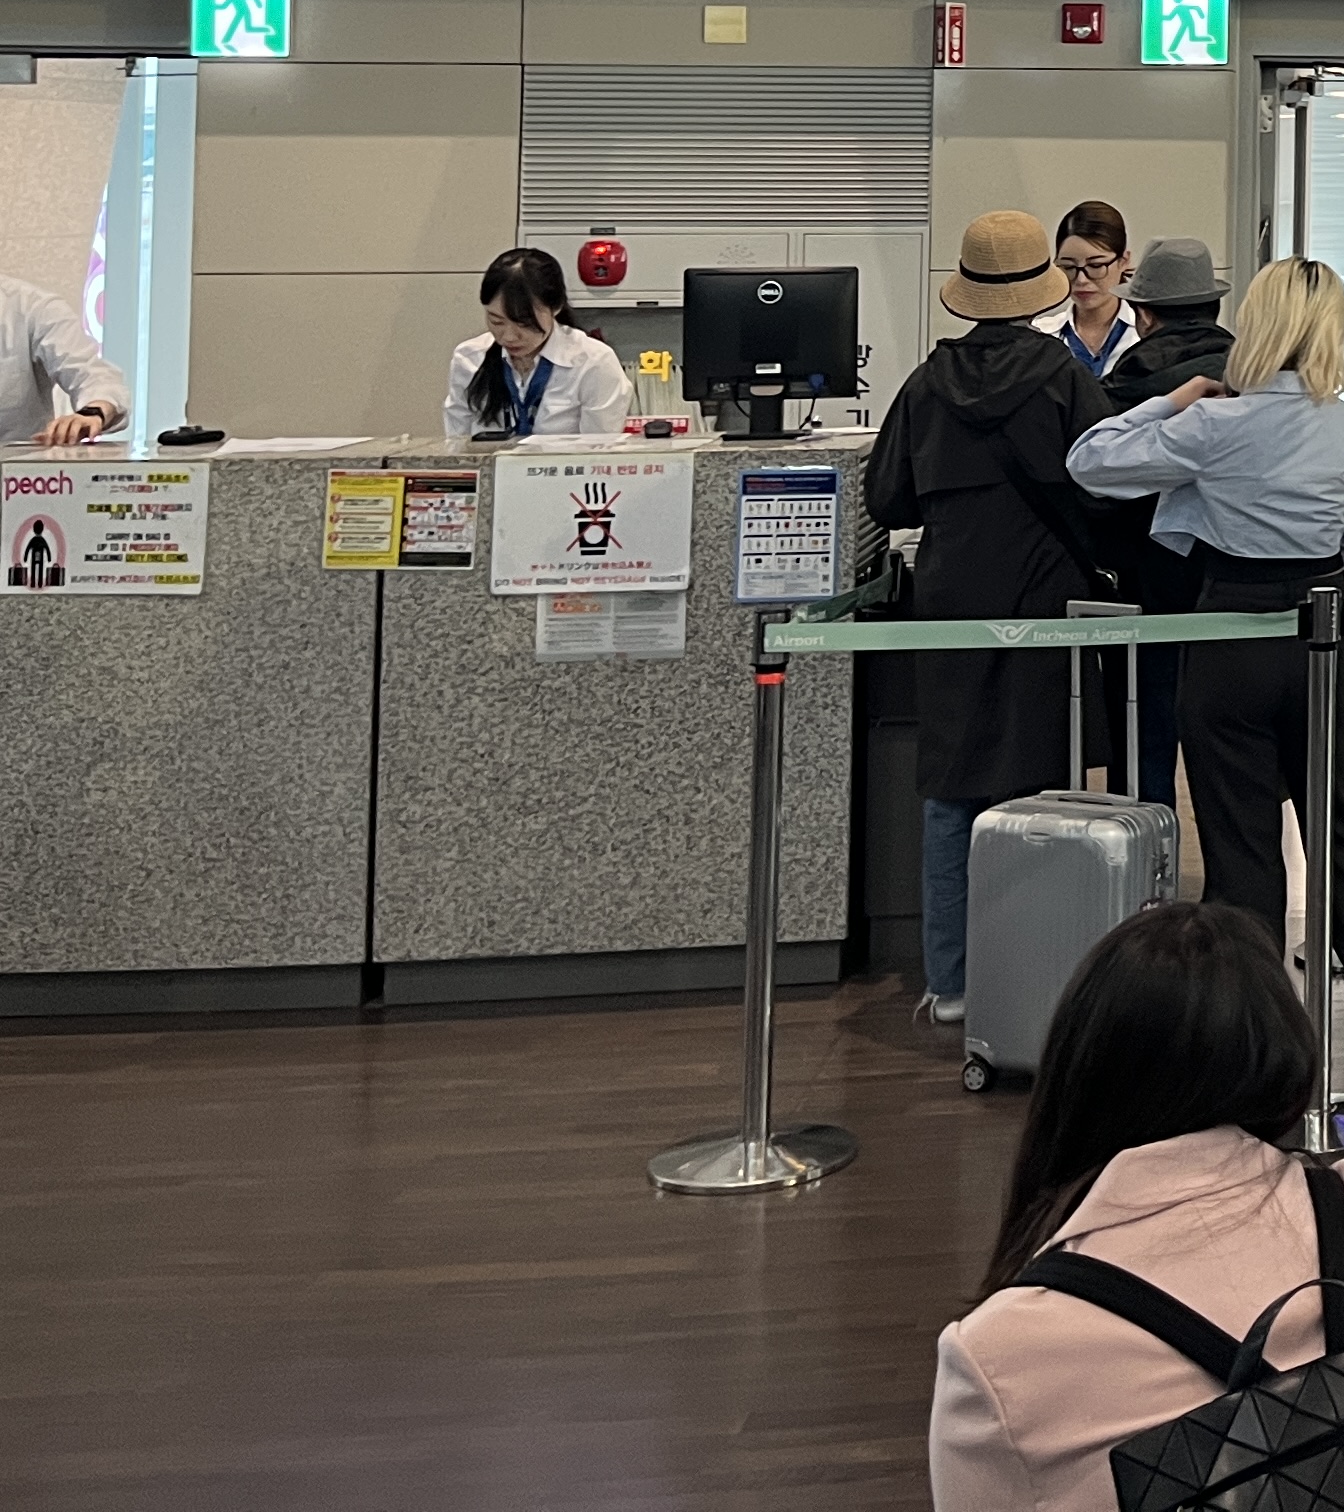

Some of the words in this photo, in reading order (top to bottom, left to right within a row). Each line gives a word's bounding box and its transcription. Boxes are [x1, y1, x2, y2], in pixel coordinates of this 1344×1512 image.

[640, 351, 672, 382] 화
[4, 470, 73, 501] peach
[773, 635, 826, 647] Airport
[1092, 628, 1140, 641] Airport
